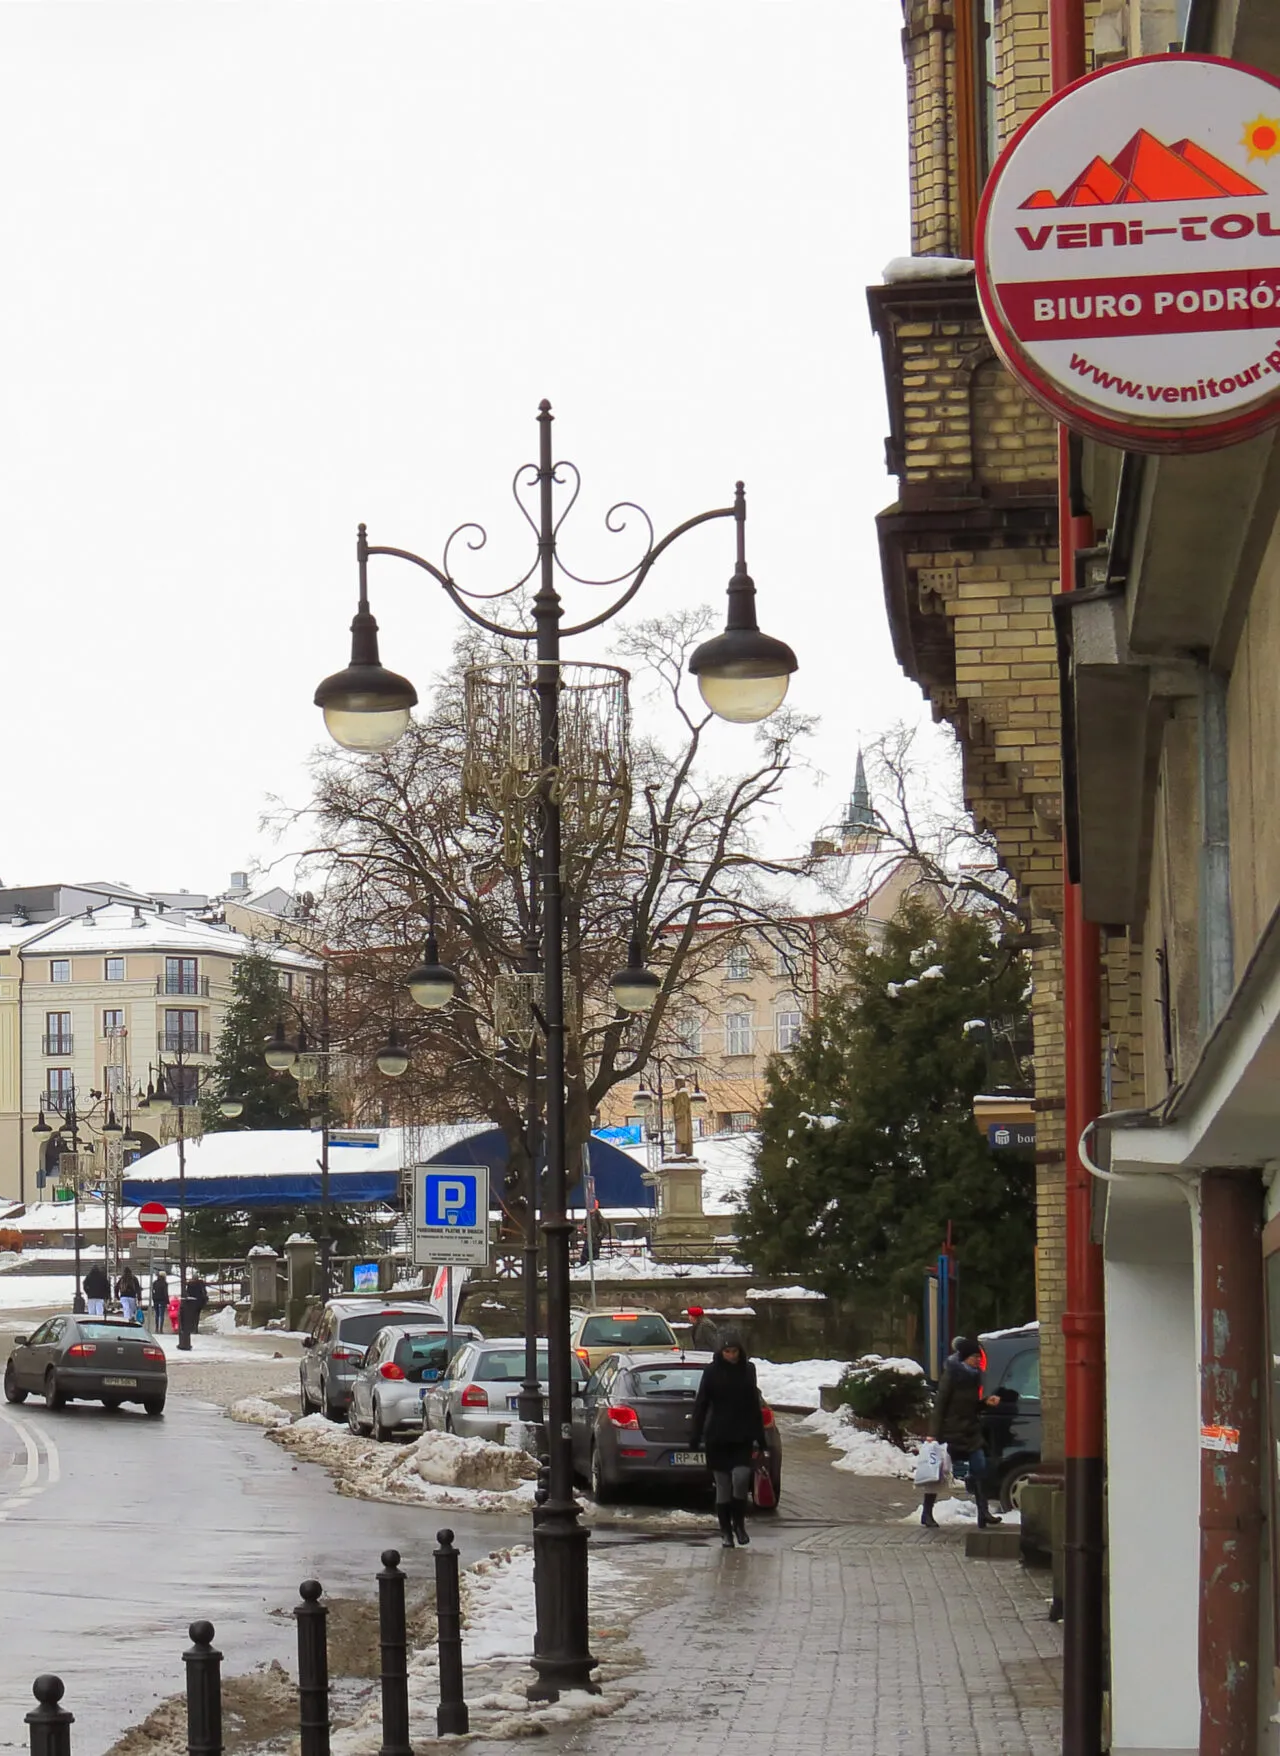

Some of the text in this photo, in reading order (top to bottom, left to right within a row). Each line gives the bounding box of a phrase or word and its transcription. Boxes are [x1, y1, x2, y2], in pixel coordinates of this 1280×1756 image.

[1033, 281, 1280, 321] BIURO PODRÓ
[1069, 339, 1280, 403] www.venitour.p
